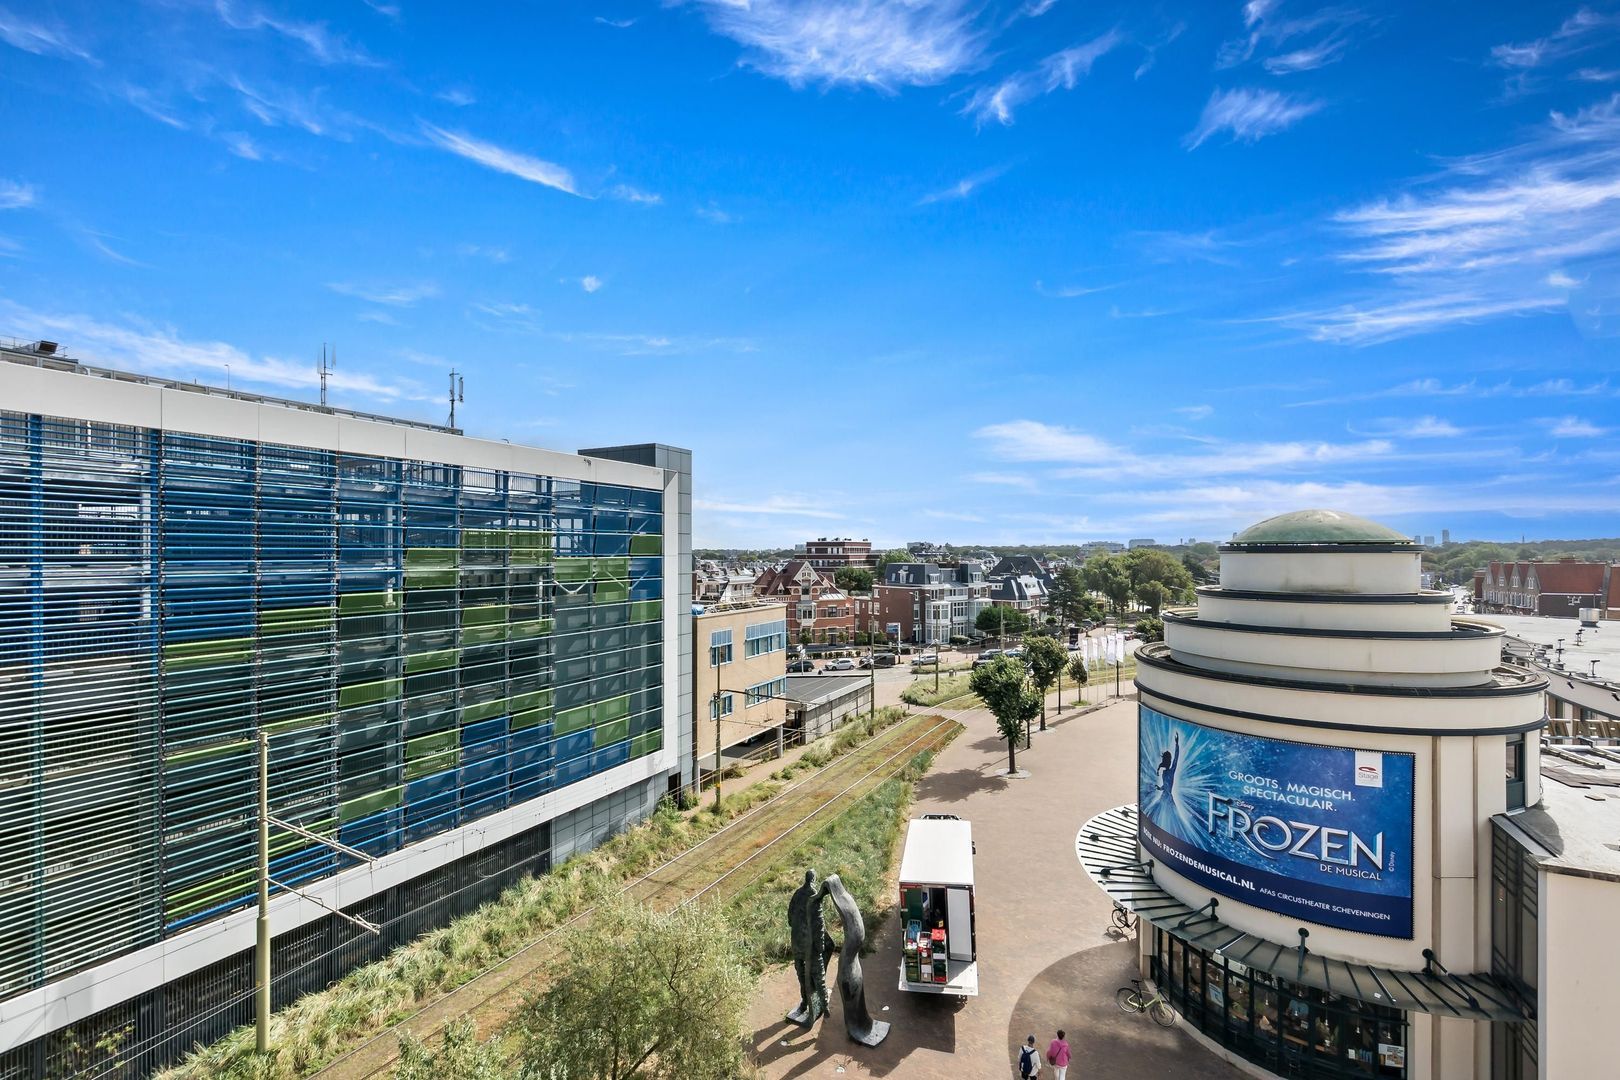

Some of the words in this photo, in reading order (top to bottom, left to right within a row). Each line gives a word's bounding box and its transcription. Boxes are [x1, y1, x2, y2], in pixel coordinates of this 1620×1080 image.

[1228, 770, 1282, 790] GROOTS.
[1287, 782, 1356, 801] MAGISCH.
[1359, 772, 1379, 780] Stage
[1243, 785, 1338, 811] SPECTACULAIR.
[1207, 791, 1383, 870] FROZEN
[1163, 843, 1256, 891] FROZENDEMUSICAL.NL
[1259, 887, 1276, 897] AFAS
[1277, 892, 1330, 910] CIRCUSTHEATER
[1332, 905, 1391, 920] SCHEVENINGEN
[1320, 863, 1333, 873] DE
[1335, 867, 1382, 881] MUSICAL
